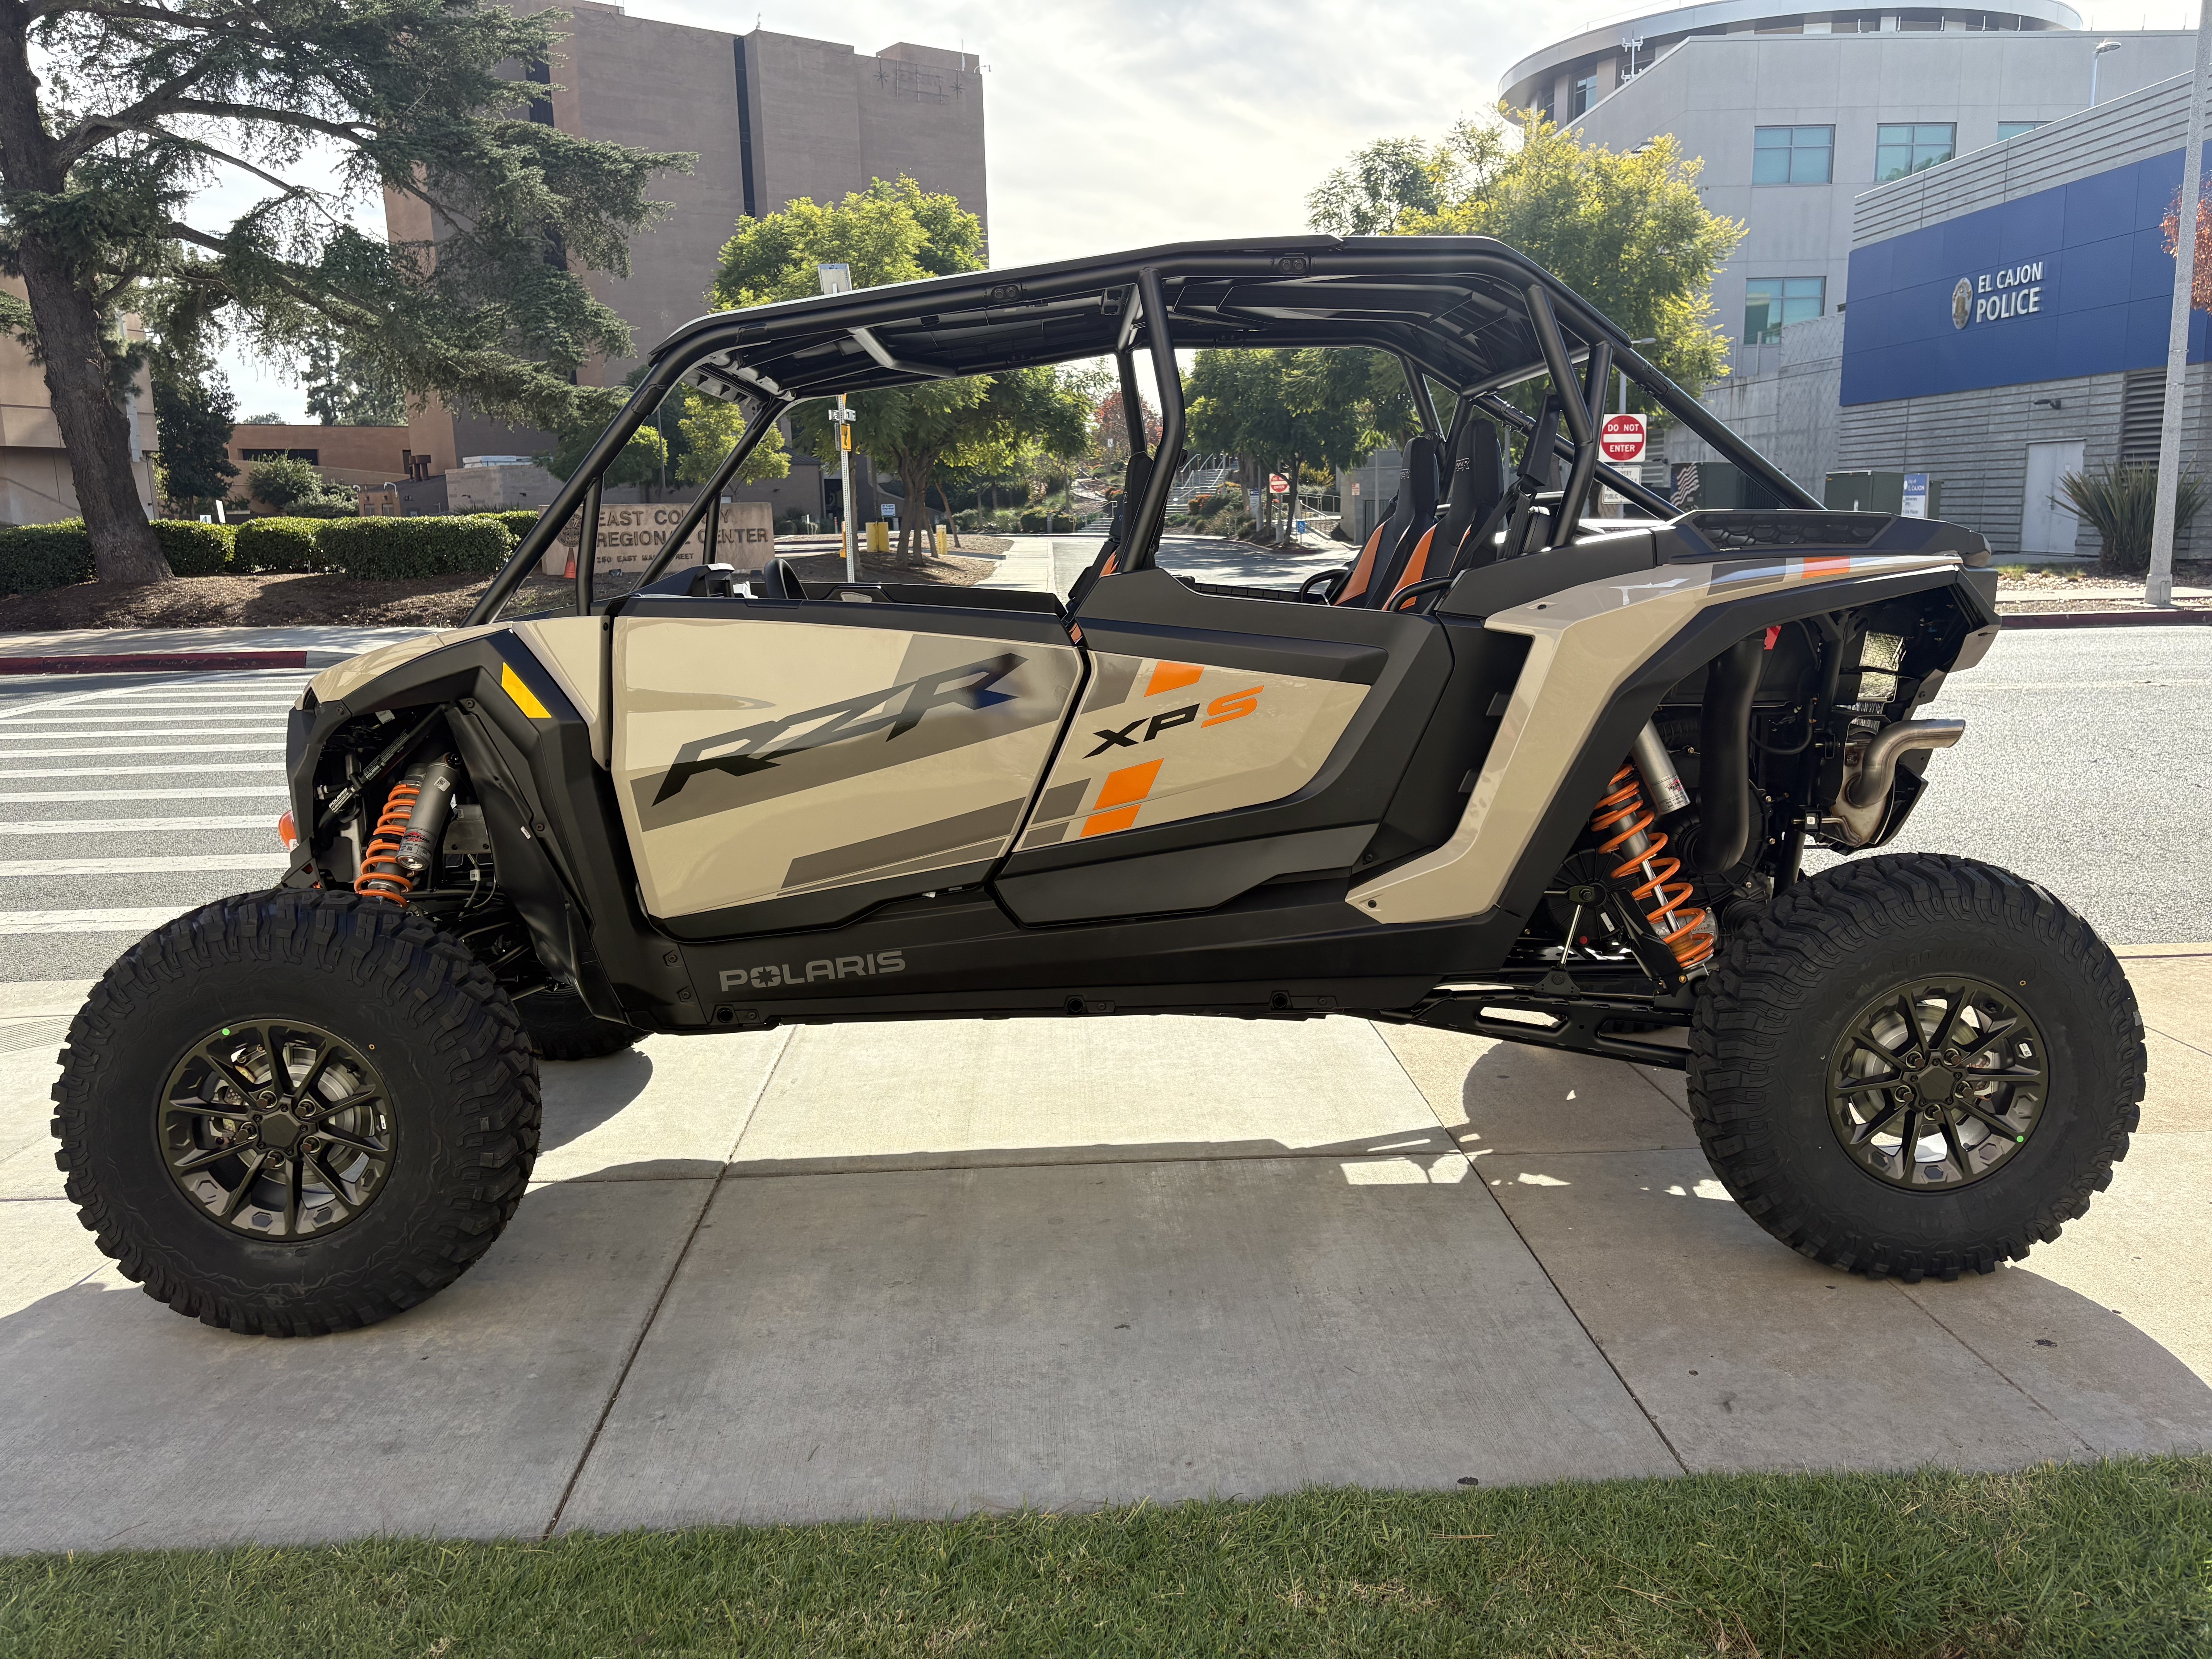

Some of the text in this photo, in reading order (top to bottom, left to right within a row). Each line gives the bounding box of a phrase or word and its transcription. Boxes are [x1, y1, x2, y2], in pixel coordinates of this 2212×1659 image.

[1978, 262, 2043, 293] EL CAJON
[1976, 287, 2041, 323] POLICE
[1623, 424, 1639, 432] NOT
[1609, 444, 1635, 452] ENTER
[599, 509, 730, 527] EAST COY
[597, 530, 690, 548] REGION
[651, 653, 1029, 807] RZR
[1081, 685, 1264, 760] XPS
[719, 950, 906, 992] POLARIS
